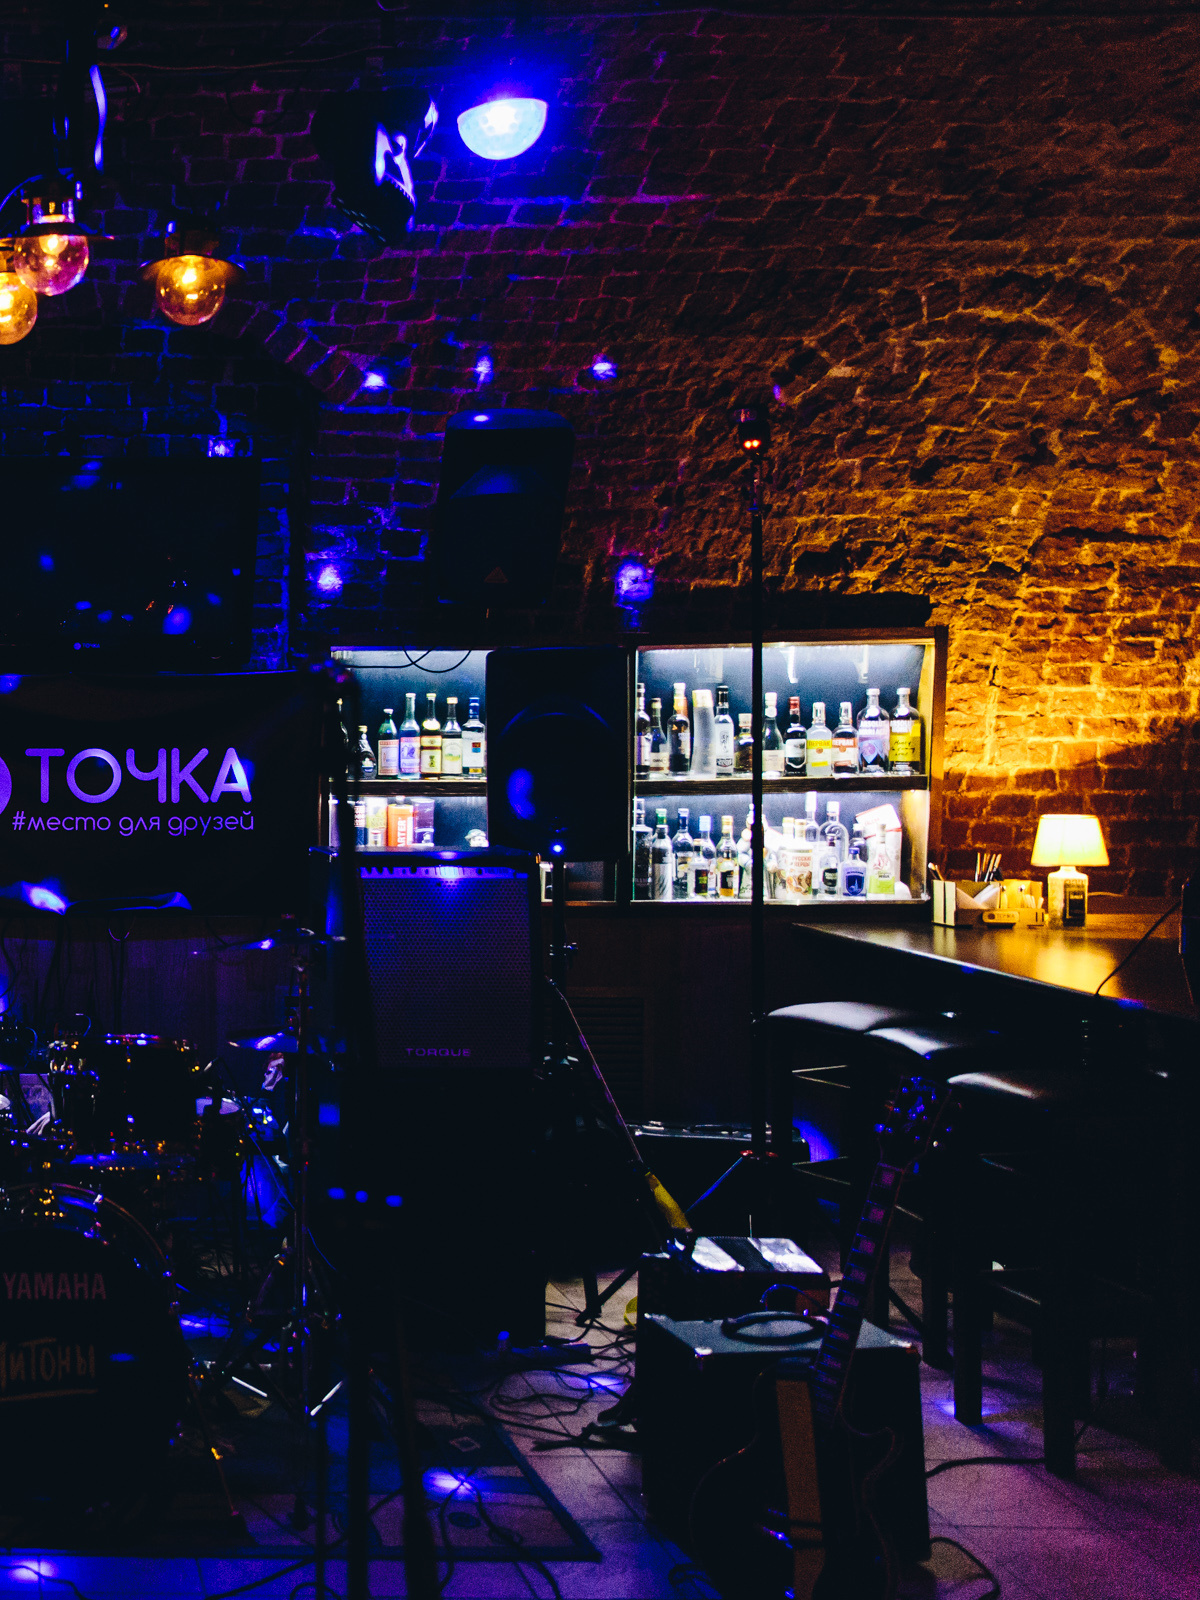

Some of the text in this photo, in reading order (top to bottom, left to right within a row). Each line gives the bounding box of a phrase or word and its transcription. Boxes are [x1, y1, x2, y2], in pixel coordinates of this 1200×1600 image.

[25, 748, 252, 804] ТОЧКА
[12, 810, 255, 837] #место для друзей
[405, 1048, 472, 1057] TORQUE
[3, 1272, 107, 1300] YAMAHA
